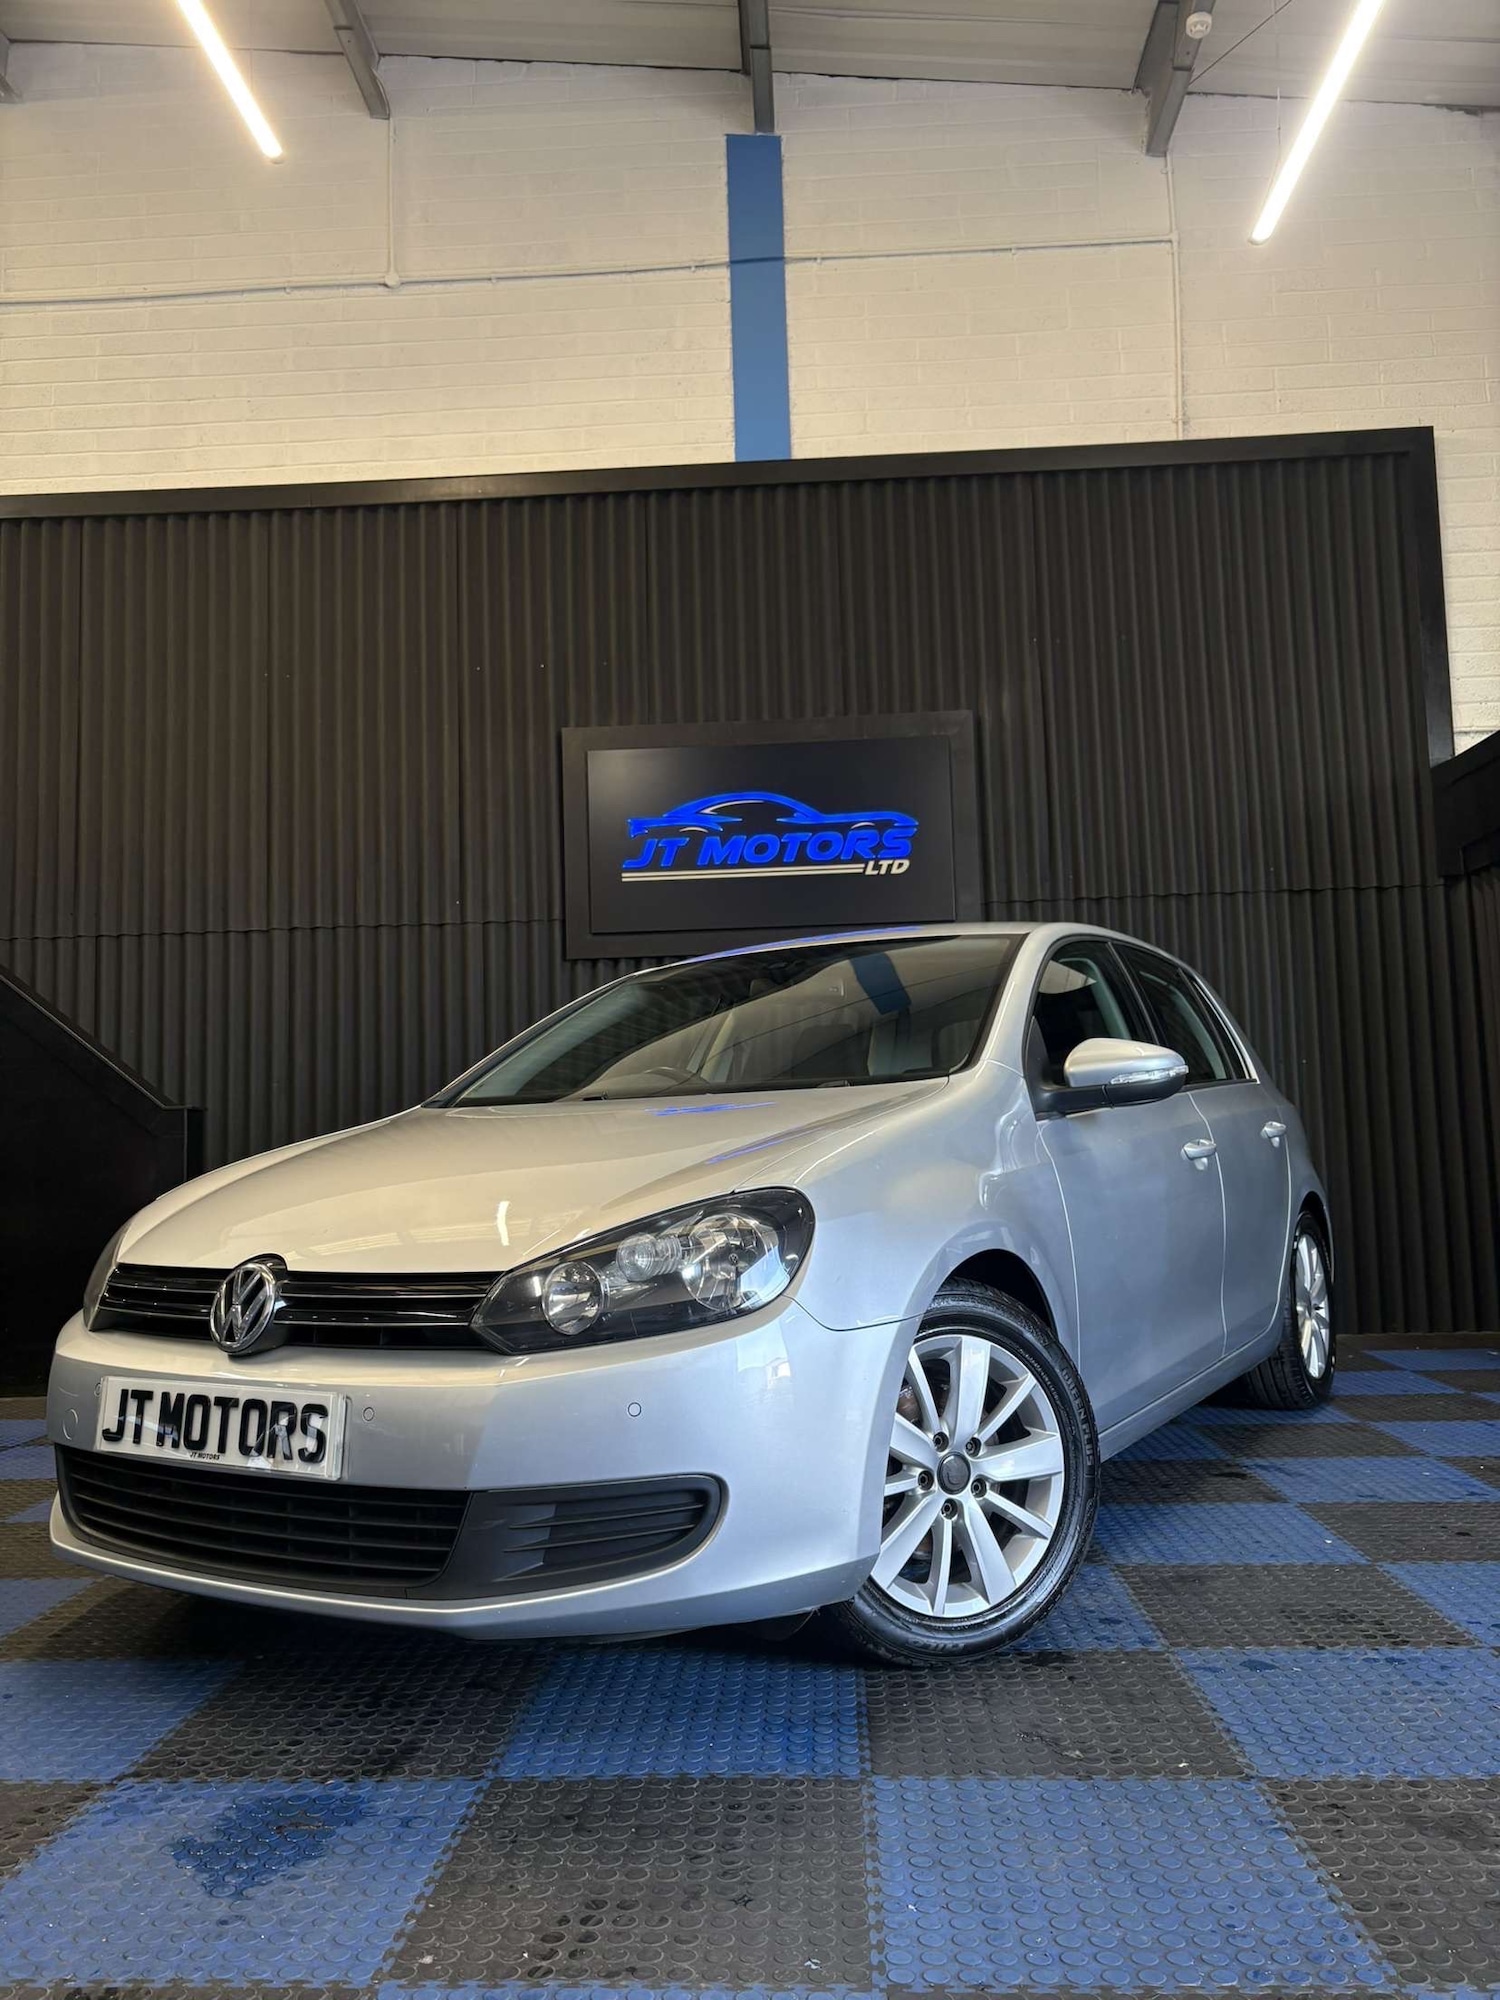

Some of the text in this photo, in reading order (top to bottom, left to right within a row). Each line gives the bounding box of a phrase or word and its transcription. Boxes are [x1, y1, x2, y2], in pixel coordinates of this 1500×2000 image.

[622, 827, 918, 868] JT MOTORS
[864, 859, 911, 876] LTD
[102, 1389, 329, 1464] JT MOTORS
[197, 1452, 221, 1461] MOTORS
